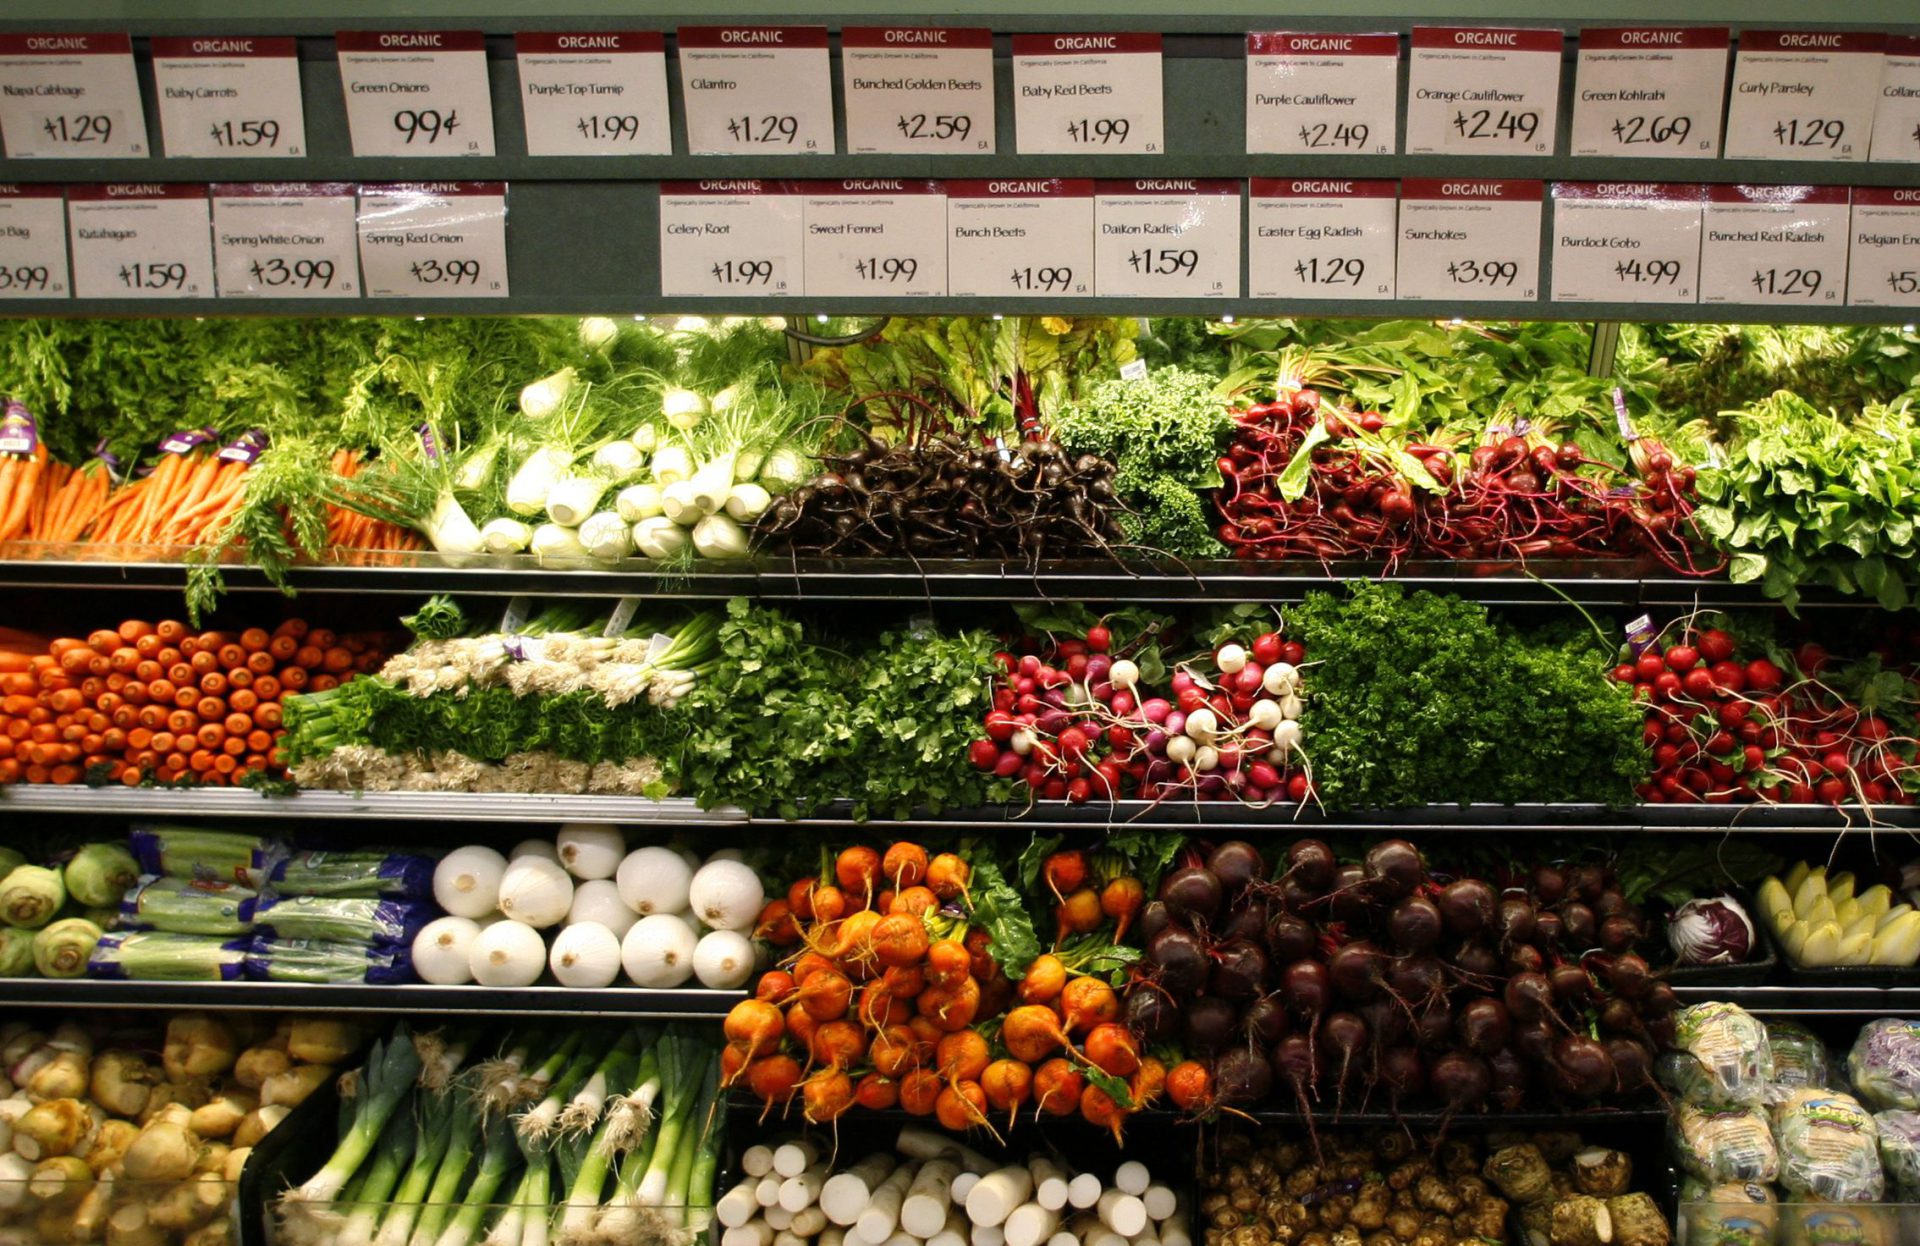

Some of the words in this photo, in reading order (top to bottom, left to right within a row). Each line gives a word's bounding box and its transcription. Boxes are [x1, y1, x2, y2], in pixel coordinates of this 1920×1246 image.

[380, 35, 442, 46] ORGANIC
[558, 36, 620, 48] ORGANIC
[721, 31, 783, 43] ORGANIC
[884, 30, 947, 43] ORGANIC
[1455, 32, 1517, 45] ORGANIC
[1621, 32, 1683, 44] ORGANIC
[1779, 34, 1842, 46] ORGANIC
[27, 37, 88, 49] ORGANIC
[193, 41, 253, 53] ORGANIC
[1054, 37, 1116, 49] ORGANIC
[1290, 39, 1352, 50] ORGANIC
[351, 81, 388, 93] Green
[389, 82, 430, 93] Onions
[528, 84, 566, 96] Purple
[567, 84, 588, 96] Top
[589, 84, 624, 95] Turnip
[691, 79, 737, 90] Cilantro
[853, 78, 902, 90] Bunched
[904, 79, 946, 90] Golden
[948, 80, 982, 90] Beets
[1739, 82, 1769, 95] Curly
[1770, 82, 1814, 96] Parsley
[3, 85, 34, 97] Napa
[35, 85, 86, 99] Cabbage
[165, 87, 194, 100] Baby
[196, 87, 238, 98] Carrots
[1022, 86, 1052, 99] Baby
[1054, 85, 1076, 96] Red
[1079, 84, 1112, 95] Beets
[1416, 88, 1460, 103] Orange
[1462, 89, 1524, 102] Cauliflower
[1582, 90, 1616, 101] Green
[1620, 90, 1666, 100] Kohlrabi
[1256, 94, 1292, 106] Purple
[1293, 94, 1356, 105] Cauliflower
[44, 115, 112, 144] $1.29
[394, 109, 461, 144] 99¢
[577, 116, 639, 140] $1.99
[728, 116, 798, 144] $1.29
[898, 114, 971, 141] $2.59
[1067, 119, 1130, 144] $1.99
[1454, 110, 1539, 142] $2.49
[1612, 116, 1691, 145] $2.69
[211, 120, 279, 148] $1.59
[1298, 124, 1369, 149] $2.49
[1773, 119, 1844, 148] $1.29
[131, 143, 141, 152] LB
[468, 141, 479, 150] EA
[806, 140, 817, 148] EA
[978, 141, 988, 150] EA
[1146, 144, 1156, 152] EA
[1376, 146, 1386, 154] LB
[1536, 144, 1546, 152] LB
[1700, 141, 1710, 150] EA
[1842, 145, 1852, 153] EA
[289, 146, 299, 155] EA
[107, 184, 166, 196] ORGANIC
[253, 183, 312, 192] ORGANIC
[700, 180, 761, 190] ORGANIC
[843, 180, 903, 190] ORGANIC
[989, 182, 1050, 193] ORGANIC
[1136, 180, 1197, 190] ORGANIC
[1292, 182, 1352, 193] ORGANIC
[1442, 184, 1502, 196] ORGANIC
[1596, 184, 1658, 195] ORGANIC
[1744, 187, 1806, 199] ORGANIC
[8, 226, 30, 240] Bag
[78, 228, 136, 240] Rutabagas
[667, 224, 702, 236] Celery
[706, 224, 730, 234] Root
[810, 224, 844, 234] Sweet
[846, 224, 884, 234] Fennel
[956, 227, 990, 238] Bunch
[993, 227, 1026, 238] Beets
[1102, 224, 1140, 234] Daikon
[1144, 224, 1182, 234] Radish
[1258, 226, 1294, 237] Easter
[1298, 226, 1320, 240] Egg
[1324, 226, 1362, 236] Radish
[1406, 229, 1467, 240] Sunchokes
[221, 234, 258, 248] Spring
[260, 235, 290, 244] White
[292, 235, 324, 244] Onion
[366, 233, 404, 246] Spring
[406, 233, 428, 243] Red
[430, 234, 464, 243] Onion
[1562, 236, 1608, 248] Burdock
[1610, 237, 1640, 248] Gobo
[1709, 231, 1758, 242] Bunched
[1760, 231, 1782, 242] Red
[1786, 232, 1824, 243] Radish
[1858, 234, 1900, 248] Belgian
[1128, 248, 1198, 278] $1.59
[250, 258, 334, 290] $3.99
[411, 260, 480, 284] $3.99
[712, 260, 772, 285] $1.99
[856, 258, 918, 282] $1.99
[1294, 258, 1364, 286] $1.29
[1447, 260, 1518, 286] $3.99
[1615, 259, 1680, 285] $4.99
[0, 266, 48, 290] 3.99
[119, 263, 186, 290] $1.59
[1011, 267, 1072, 292] $1.99
[188, 284, 198, 292] LB
[342, 282, 352, 290] LB
[490, 282, 500, 290] LB
[777, 282, 786, 290] LB
[1212, 282, 1222, 290] LB
[1752, 269, 1822, 297] $1.29
[1378, 286, 1388, 294] EA
[1678, 288, 1688, 296] LB
[1826, 292, 1836, 300] EA
